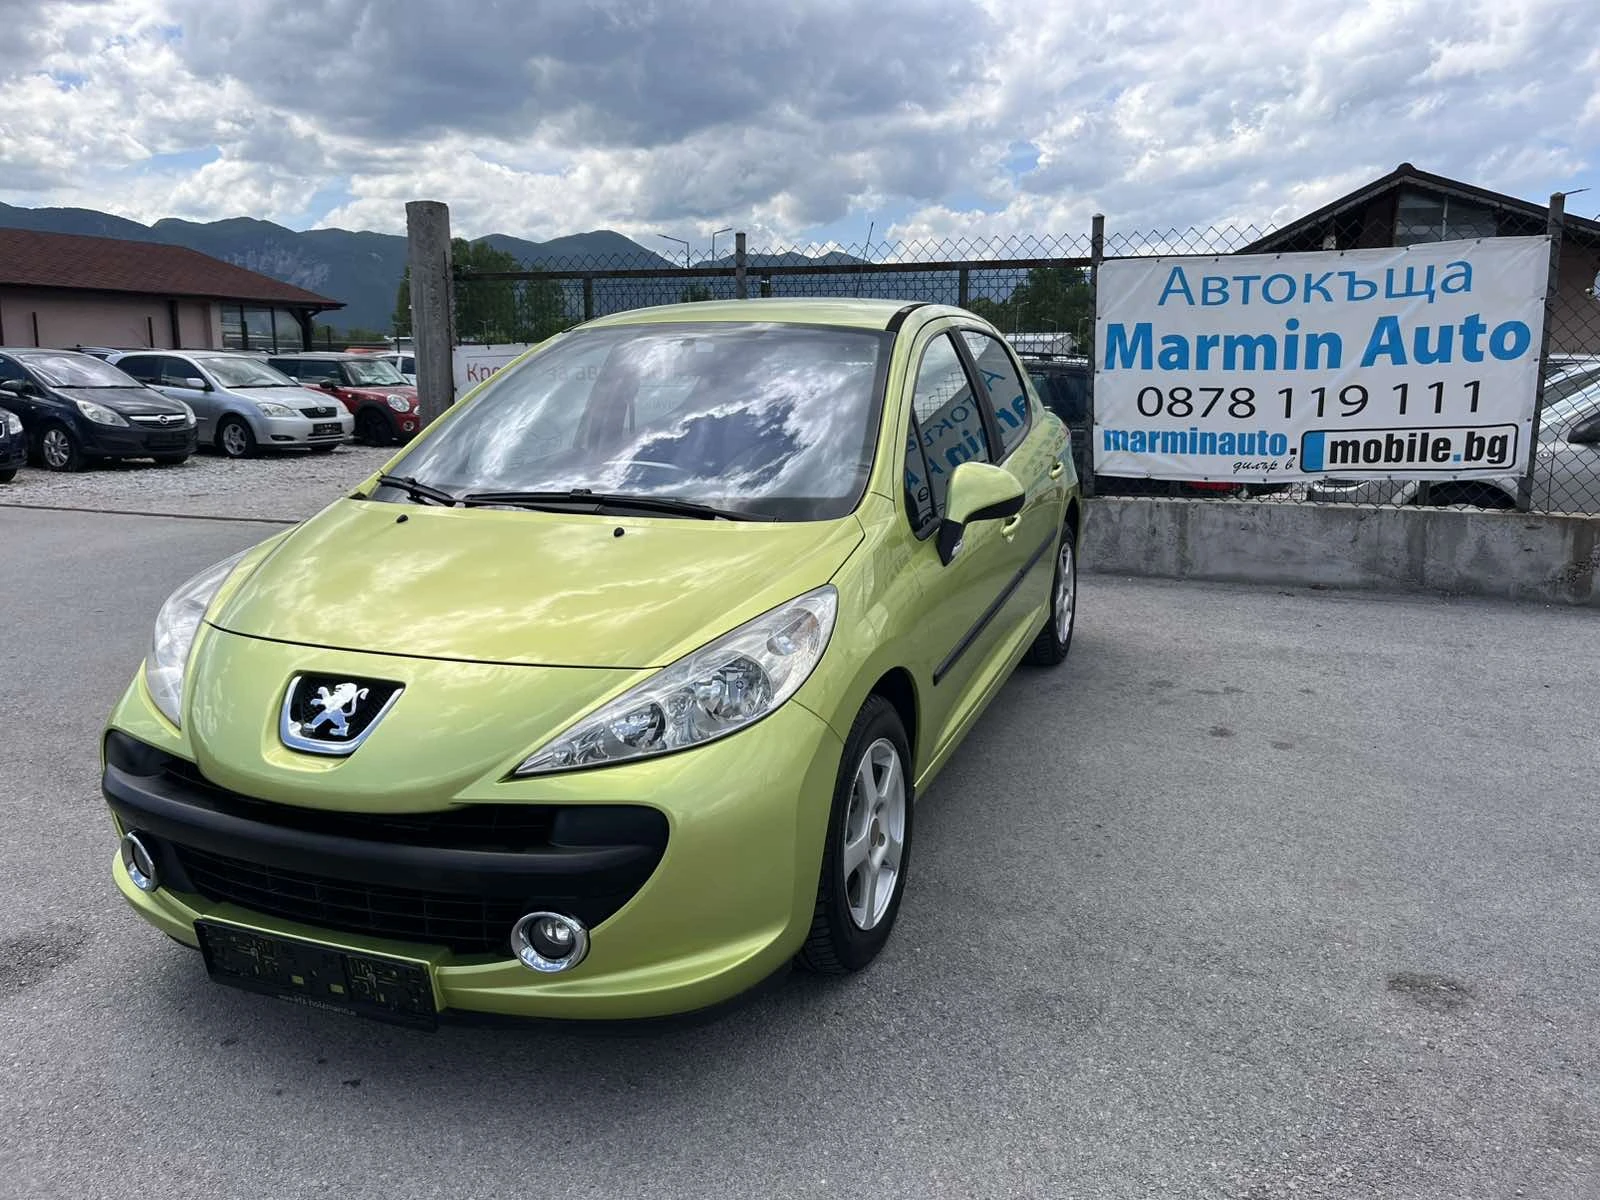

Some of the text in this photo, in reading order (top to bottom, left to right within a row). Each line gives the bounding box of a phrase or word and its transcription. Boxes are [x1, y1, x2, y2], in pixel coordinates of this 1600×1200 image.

[1158, 260, 1473, 306] Автокъща
[1104, 313, 1531, 371] Marmin Auto
[1137, 380, 1481, 419] 0878 119 111
[1329, 431, 1508, 465] mobile.bg
